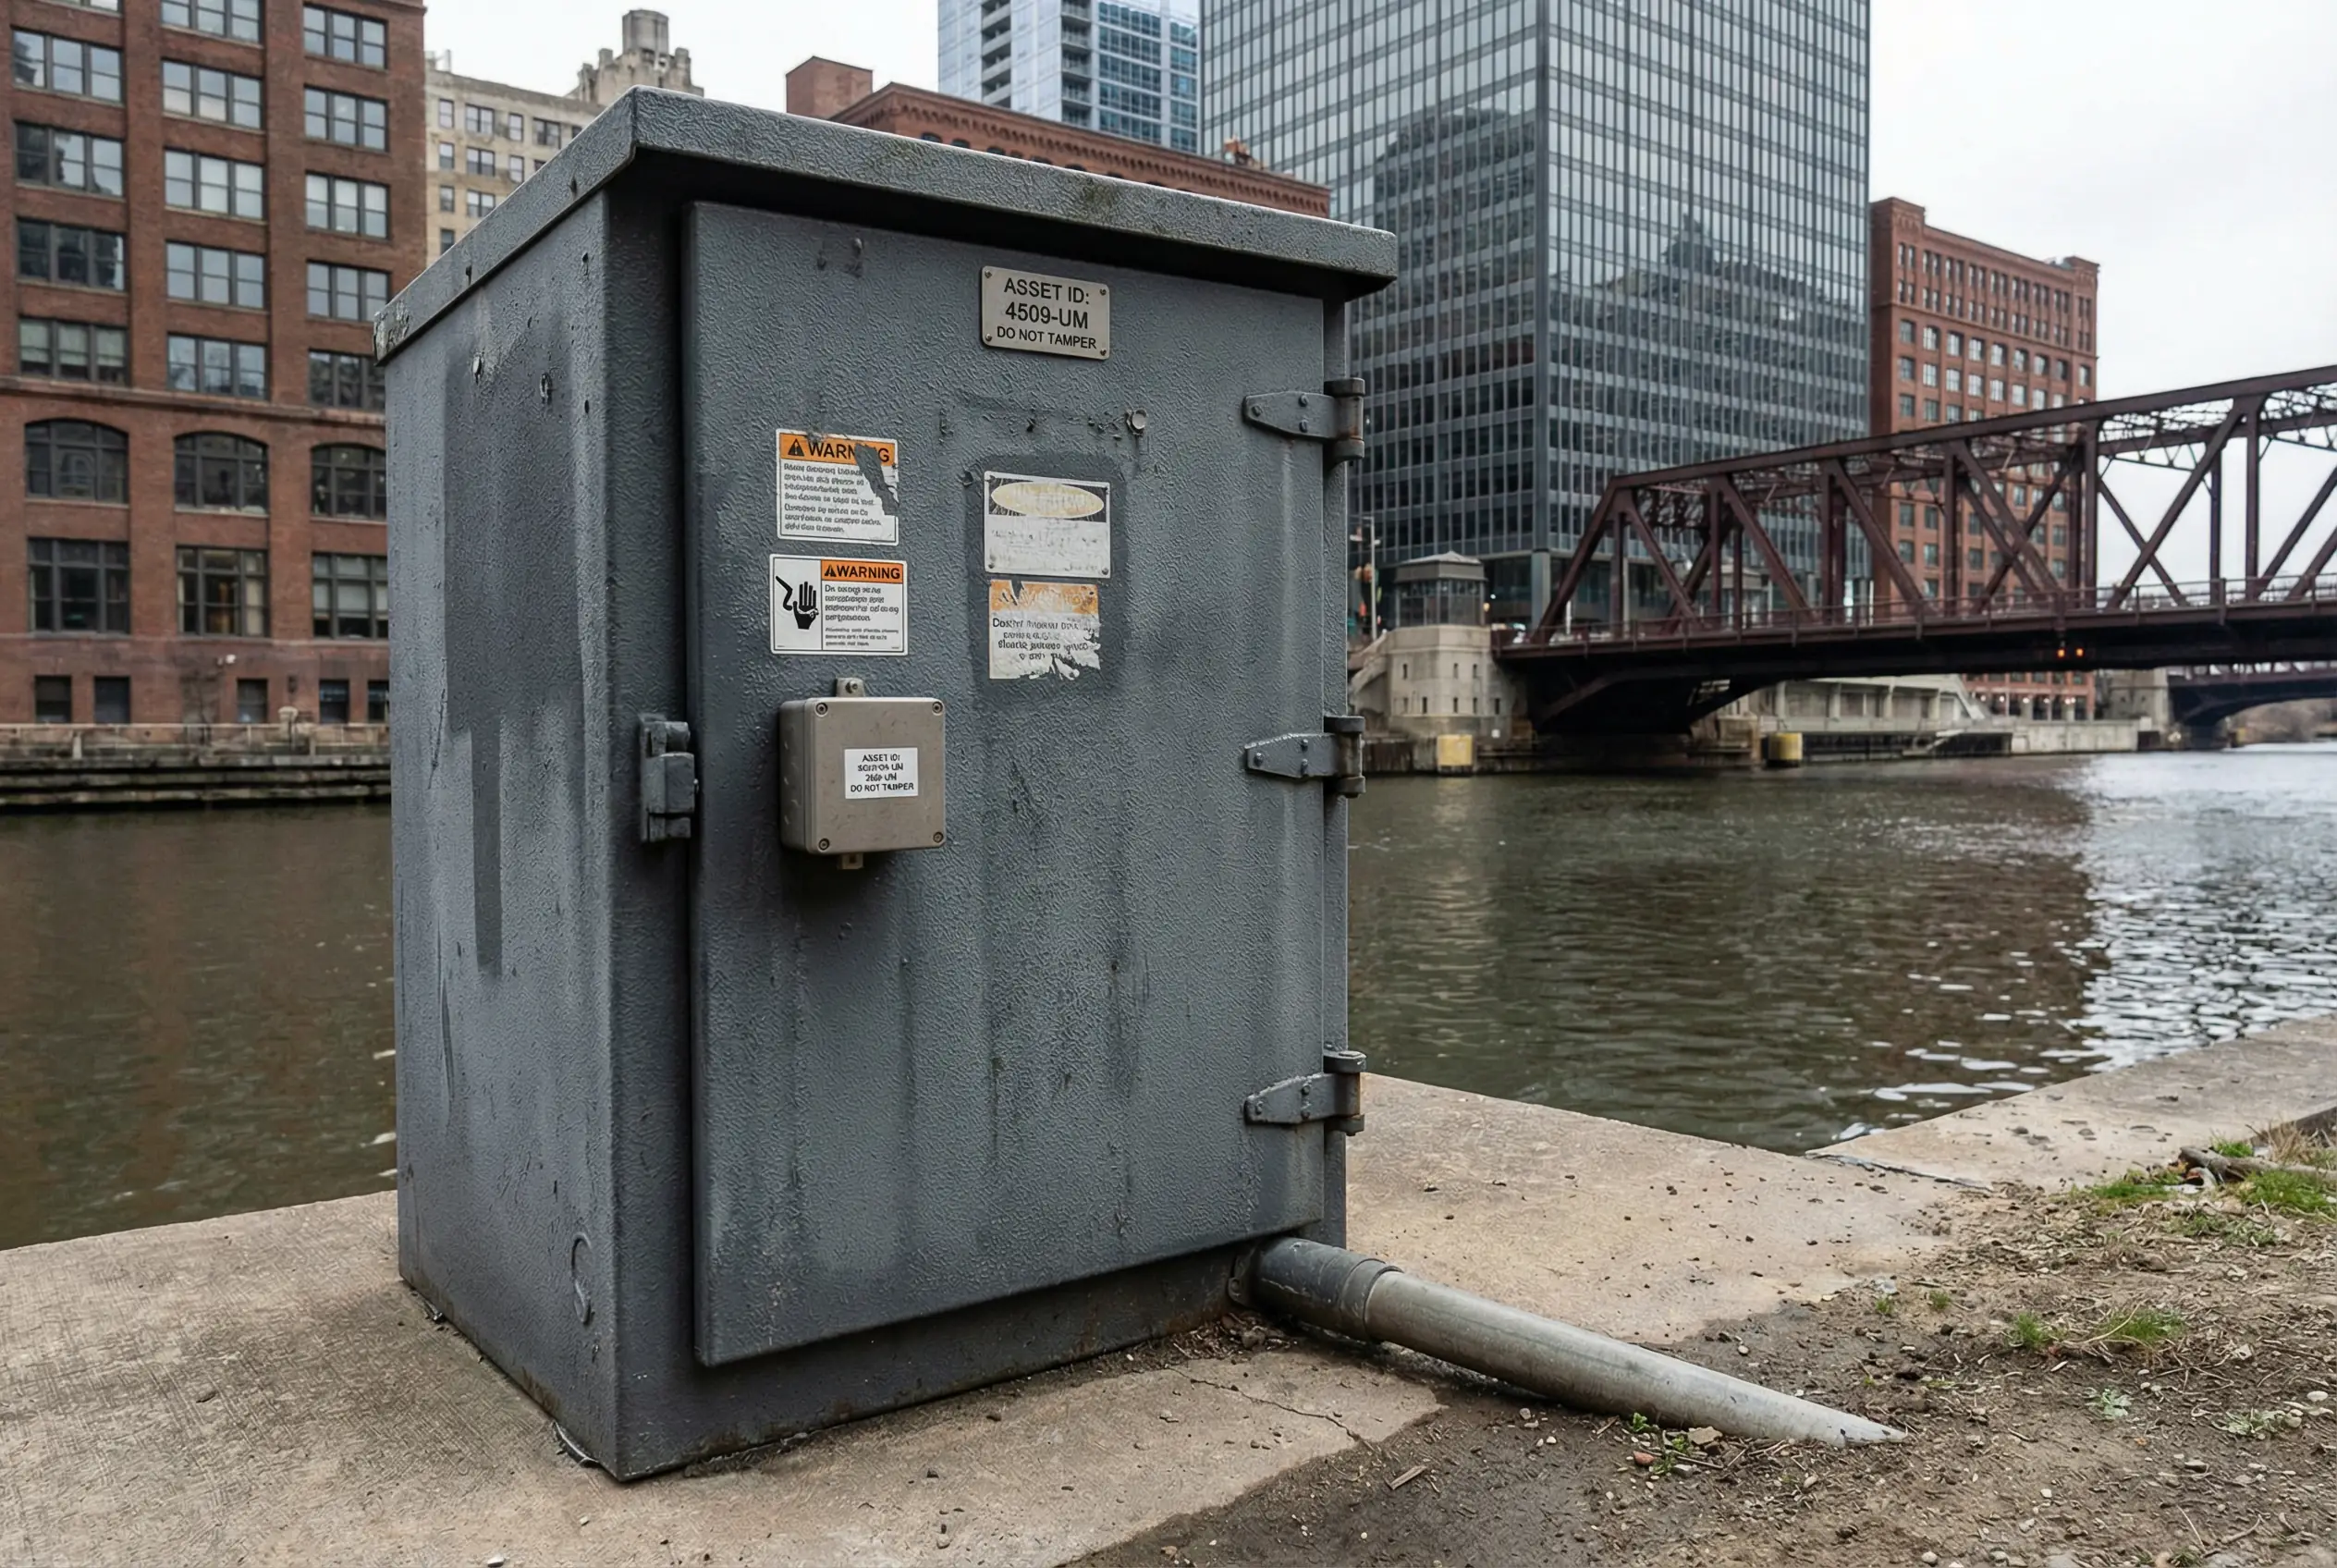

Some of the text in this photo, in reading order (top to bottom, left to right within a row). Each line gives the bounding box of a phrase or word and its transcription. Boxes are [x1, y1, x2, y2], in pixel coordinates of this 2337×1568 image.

[1004, 277, 1089, 304] ASSET ID:
[1005, 301, 1088, 329] 4509-UM
[997, 325, 1097, 349] DO NOT TAMPER
[808, 441, 889, 463] WARNG
[836, 565, 900, 580] WARNING
[850, 784, 863, 792] DO
